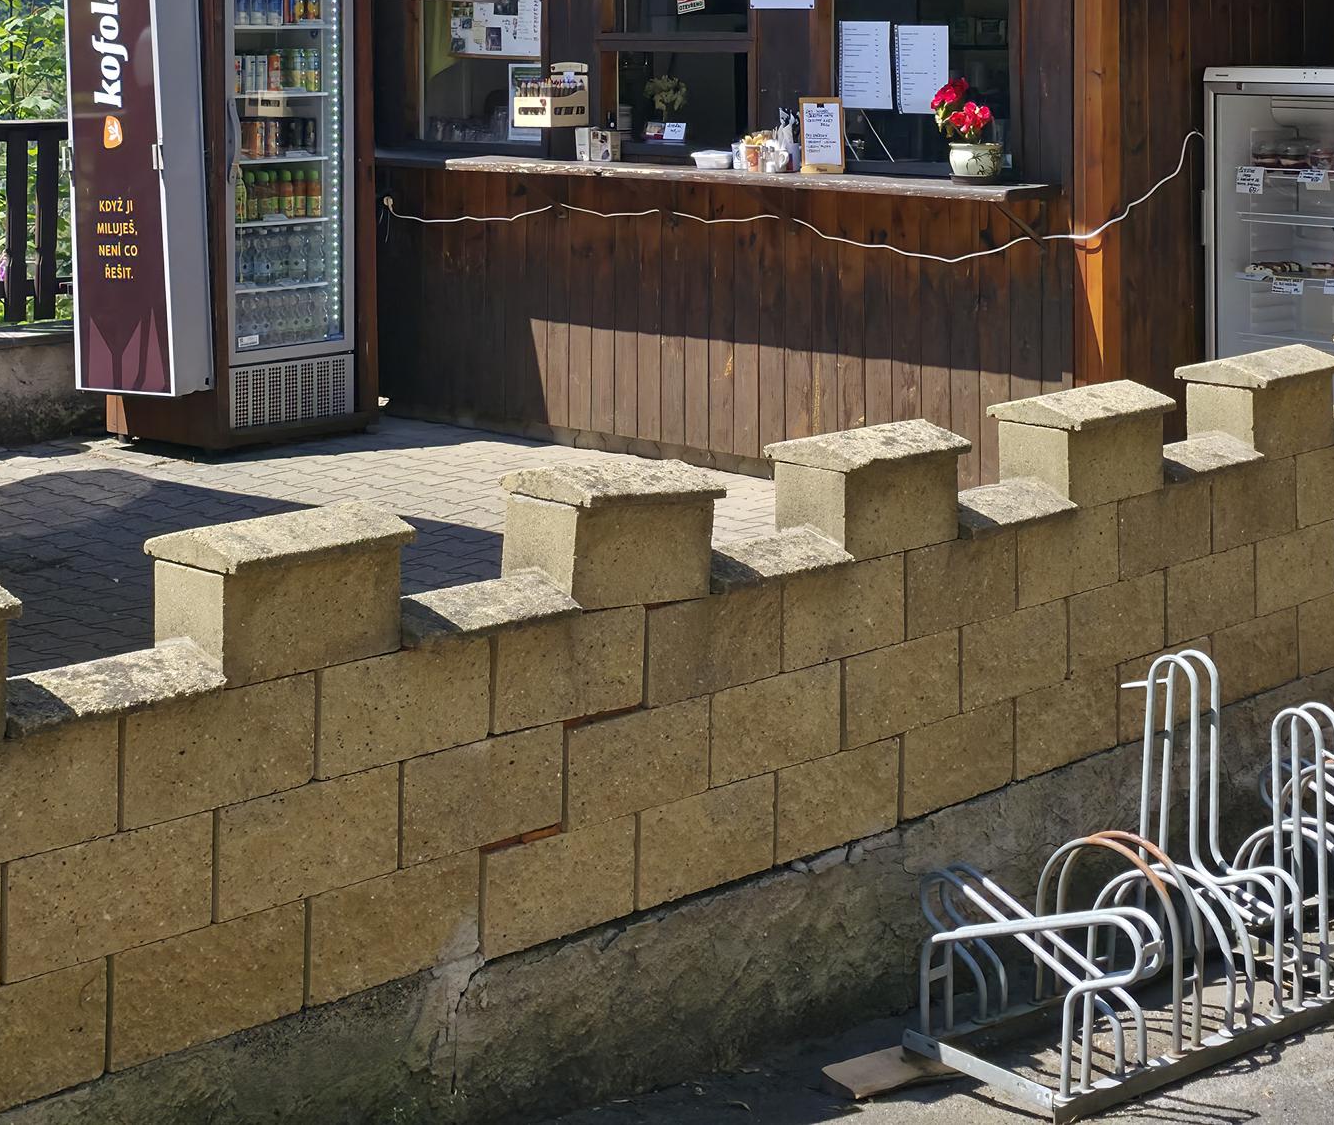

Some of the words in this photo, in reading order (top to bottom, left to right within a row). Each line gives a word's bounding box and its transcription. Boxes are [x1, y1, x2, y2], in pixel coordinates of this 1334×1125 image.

[98, 195, 124, 213] KDYŽ
[125, 200, 134, 215] JI
[97, 219, 138, 236] MILUJEŠ,
[98, 240, 122, 257] NENÍ
[124, 243, 138, 257] CO
[104, 263, 135, 280] ŘEŠIT.
